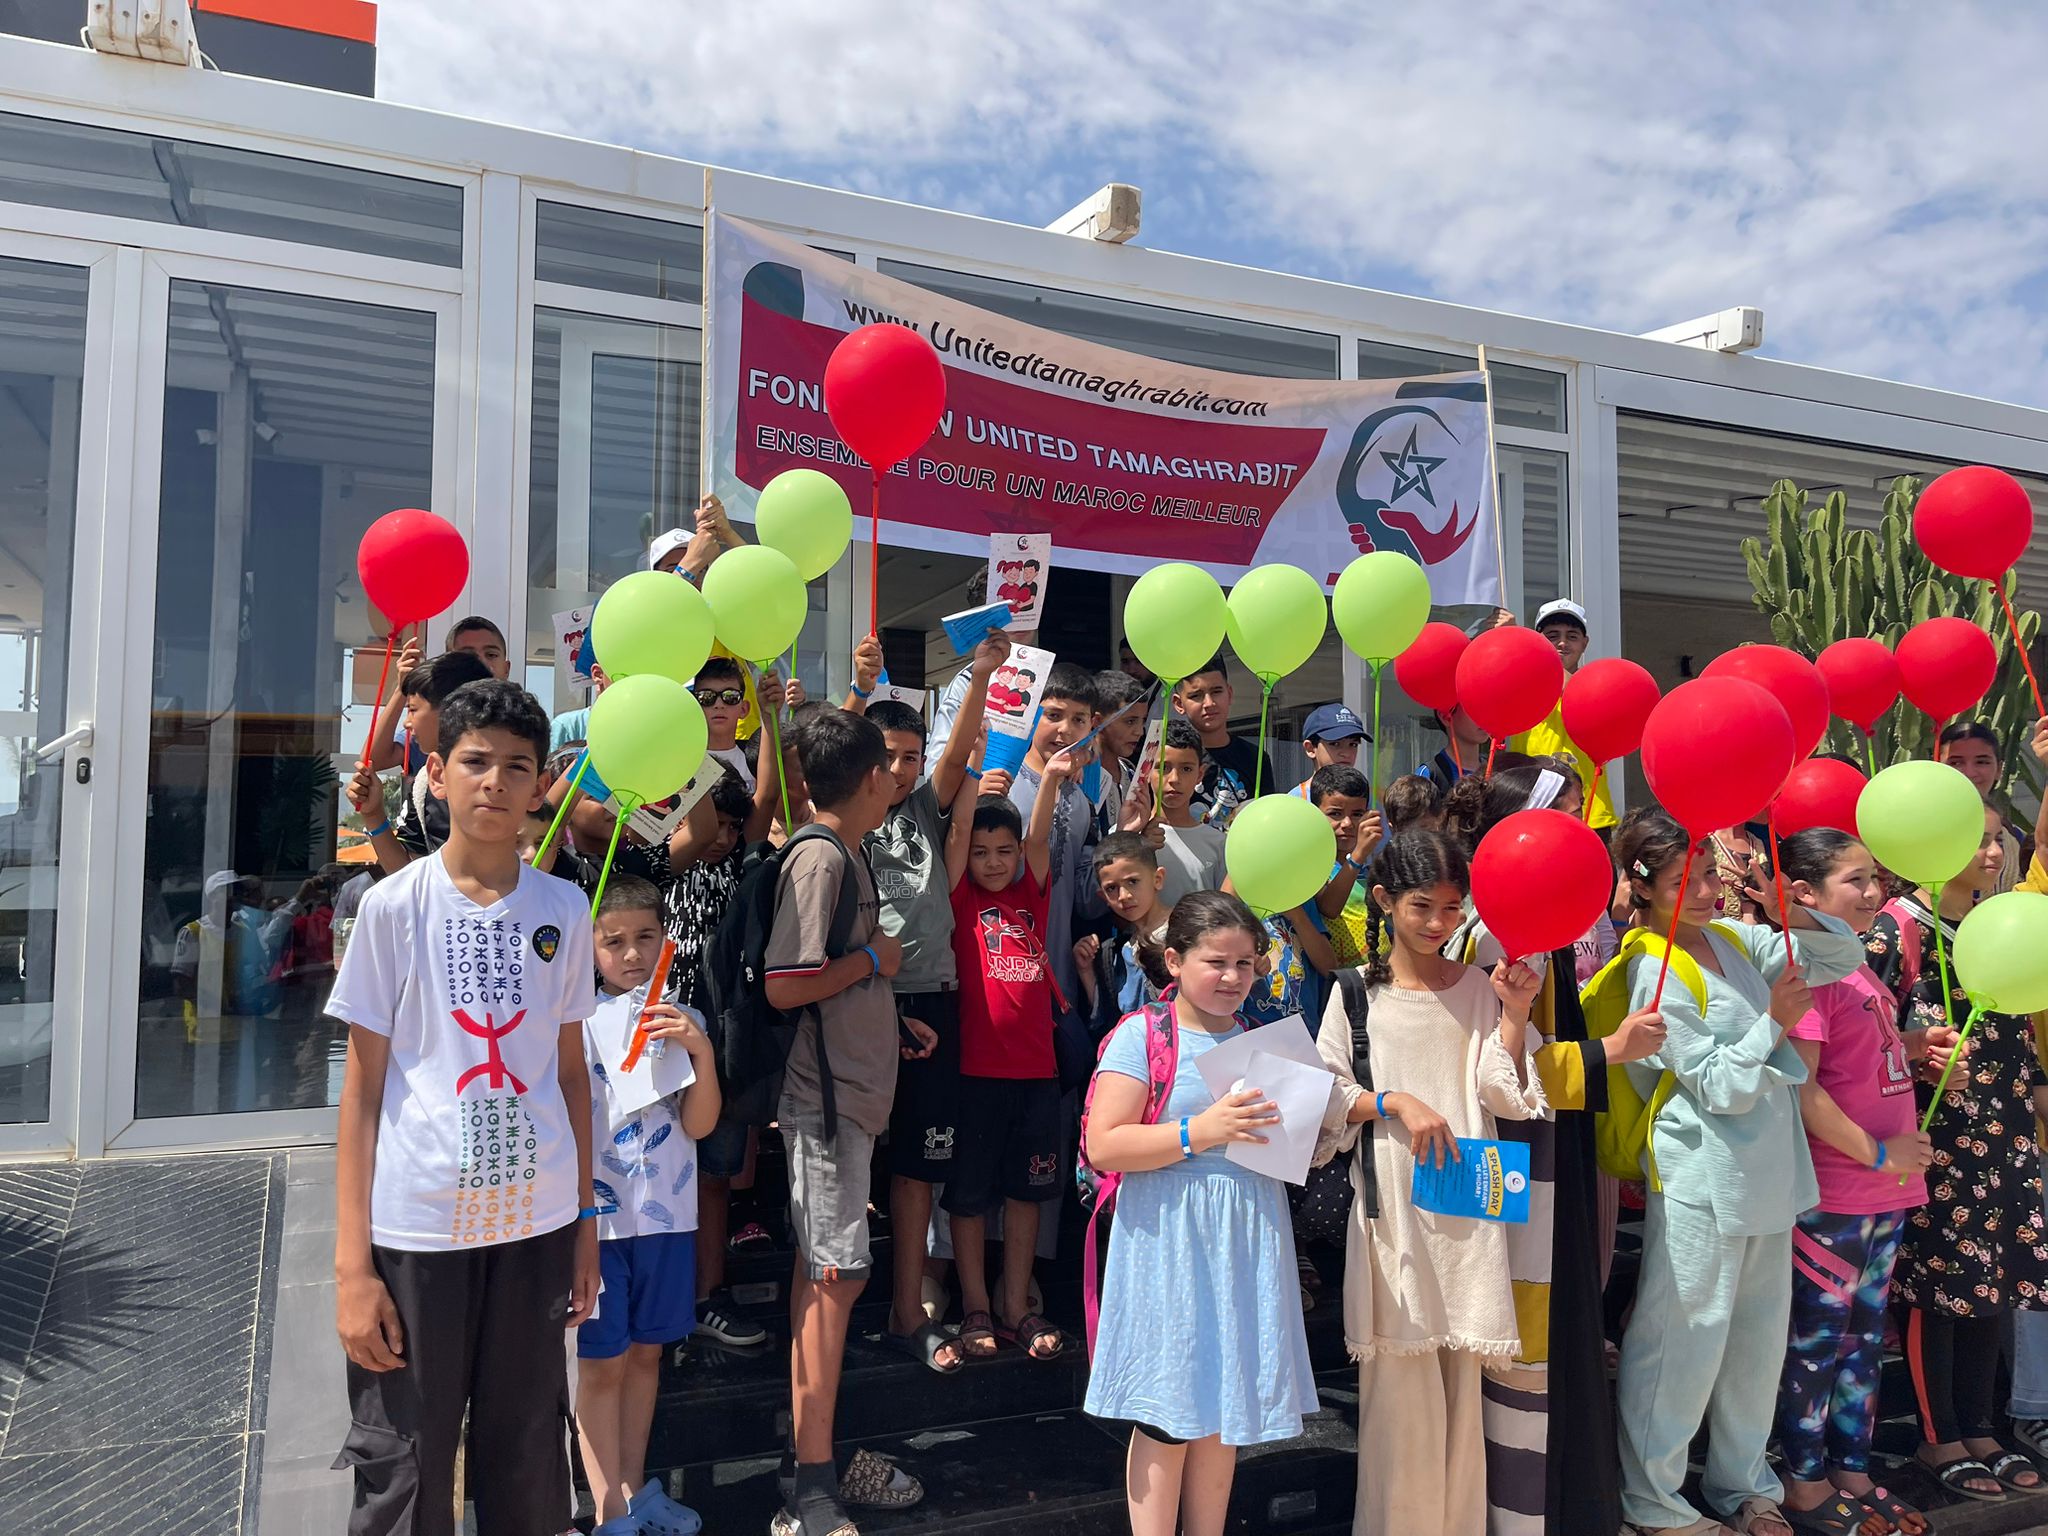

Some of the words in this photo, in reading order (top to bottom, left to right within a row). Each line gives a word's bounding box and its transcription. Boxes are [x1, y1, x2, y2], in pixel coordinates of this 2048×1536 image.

[966, 414, 1078, 462] UNITED
[1086, 443, 1298, 489] TAMAGHRABIT
[756, 424, 910, 477] ENSEME
[918, 457, 997, 492] POUR
[1005, 472, 1045, 500] UN
[1052, 480, 1147, 513] MAROC
[1150, 495, 1261, 528] MEILLEUR
[1488, 1152, 1500, 1189] SPLASH
[1480, 1180, 1488, 1209] ENFANTS
[1490, 1190, 1500, 1211] DAY
